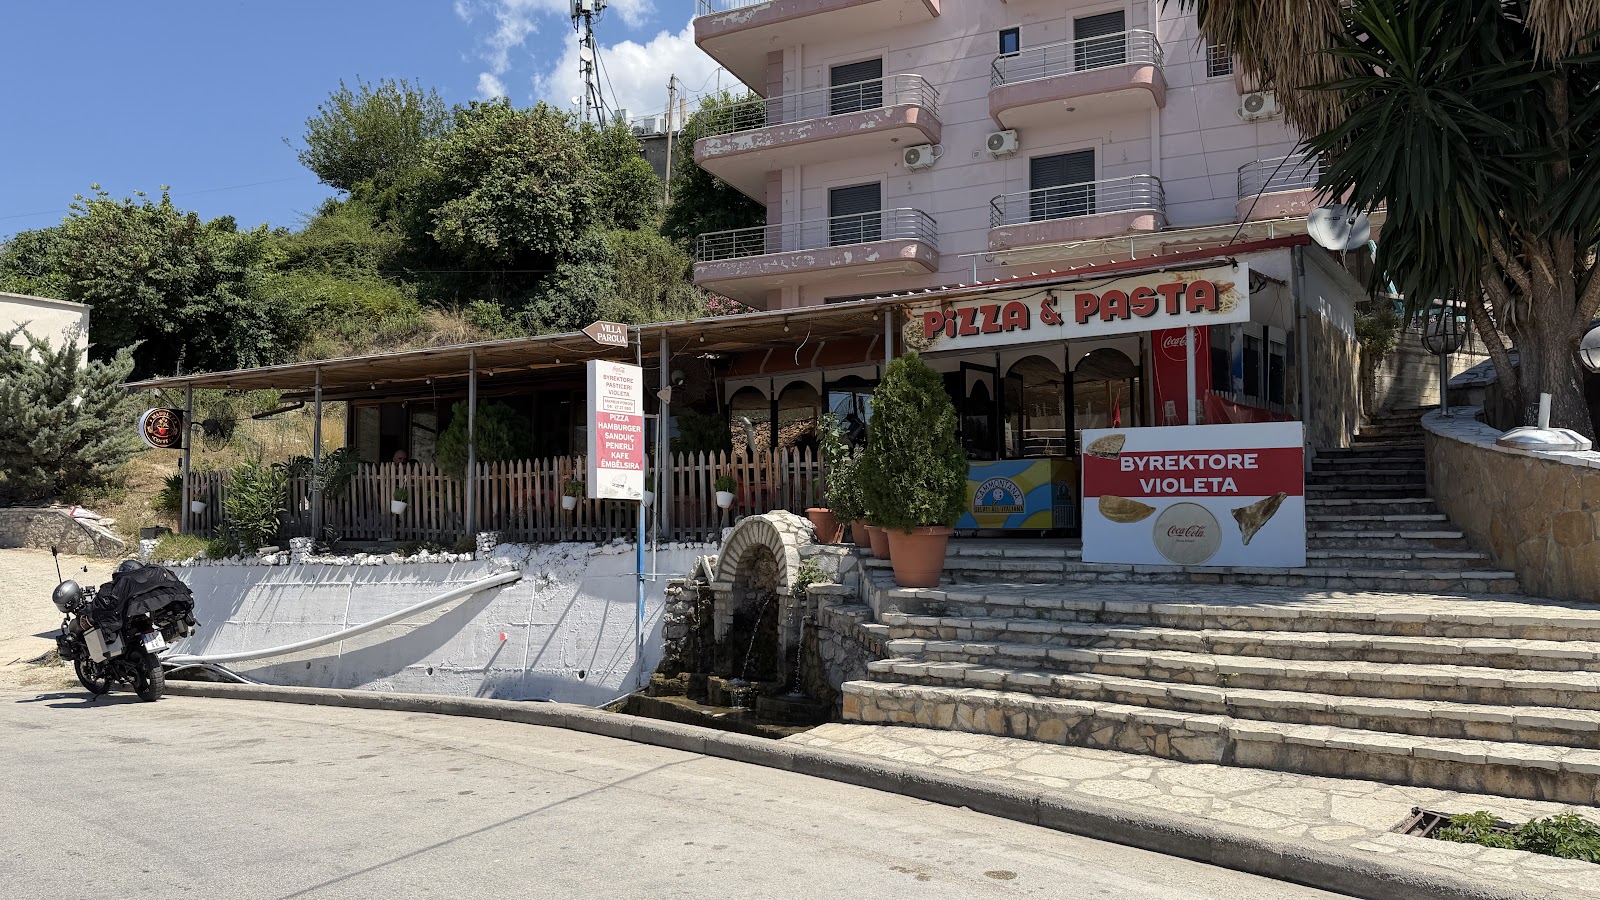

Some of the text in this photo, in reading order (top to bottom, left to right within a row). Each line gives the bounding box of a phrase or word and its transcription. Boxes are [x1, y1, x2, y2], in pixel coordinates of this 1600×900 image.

[1039, 297, 1064, 327] &
[1074, 279, 1220, 325] PASTA
[600, 324, 622, 334] VILLA
[603, 374, 634, 383] BYREKTORE
[610, 414, 629, 422] PIZZA
[598, 421, 641, 433] HAMBURGER
[604, 432, 634, 443] SANDUIÇ
[606, 442, 634, 450] PENERLI
[601, 459, 640, 469] ËMBËLSIRA
[1120, 453, 1258, 472] BYREKTORE
[977, 479, 1020, 501] SAMMONTANA
[1139, 477, 1238, 494] VIOLETA
